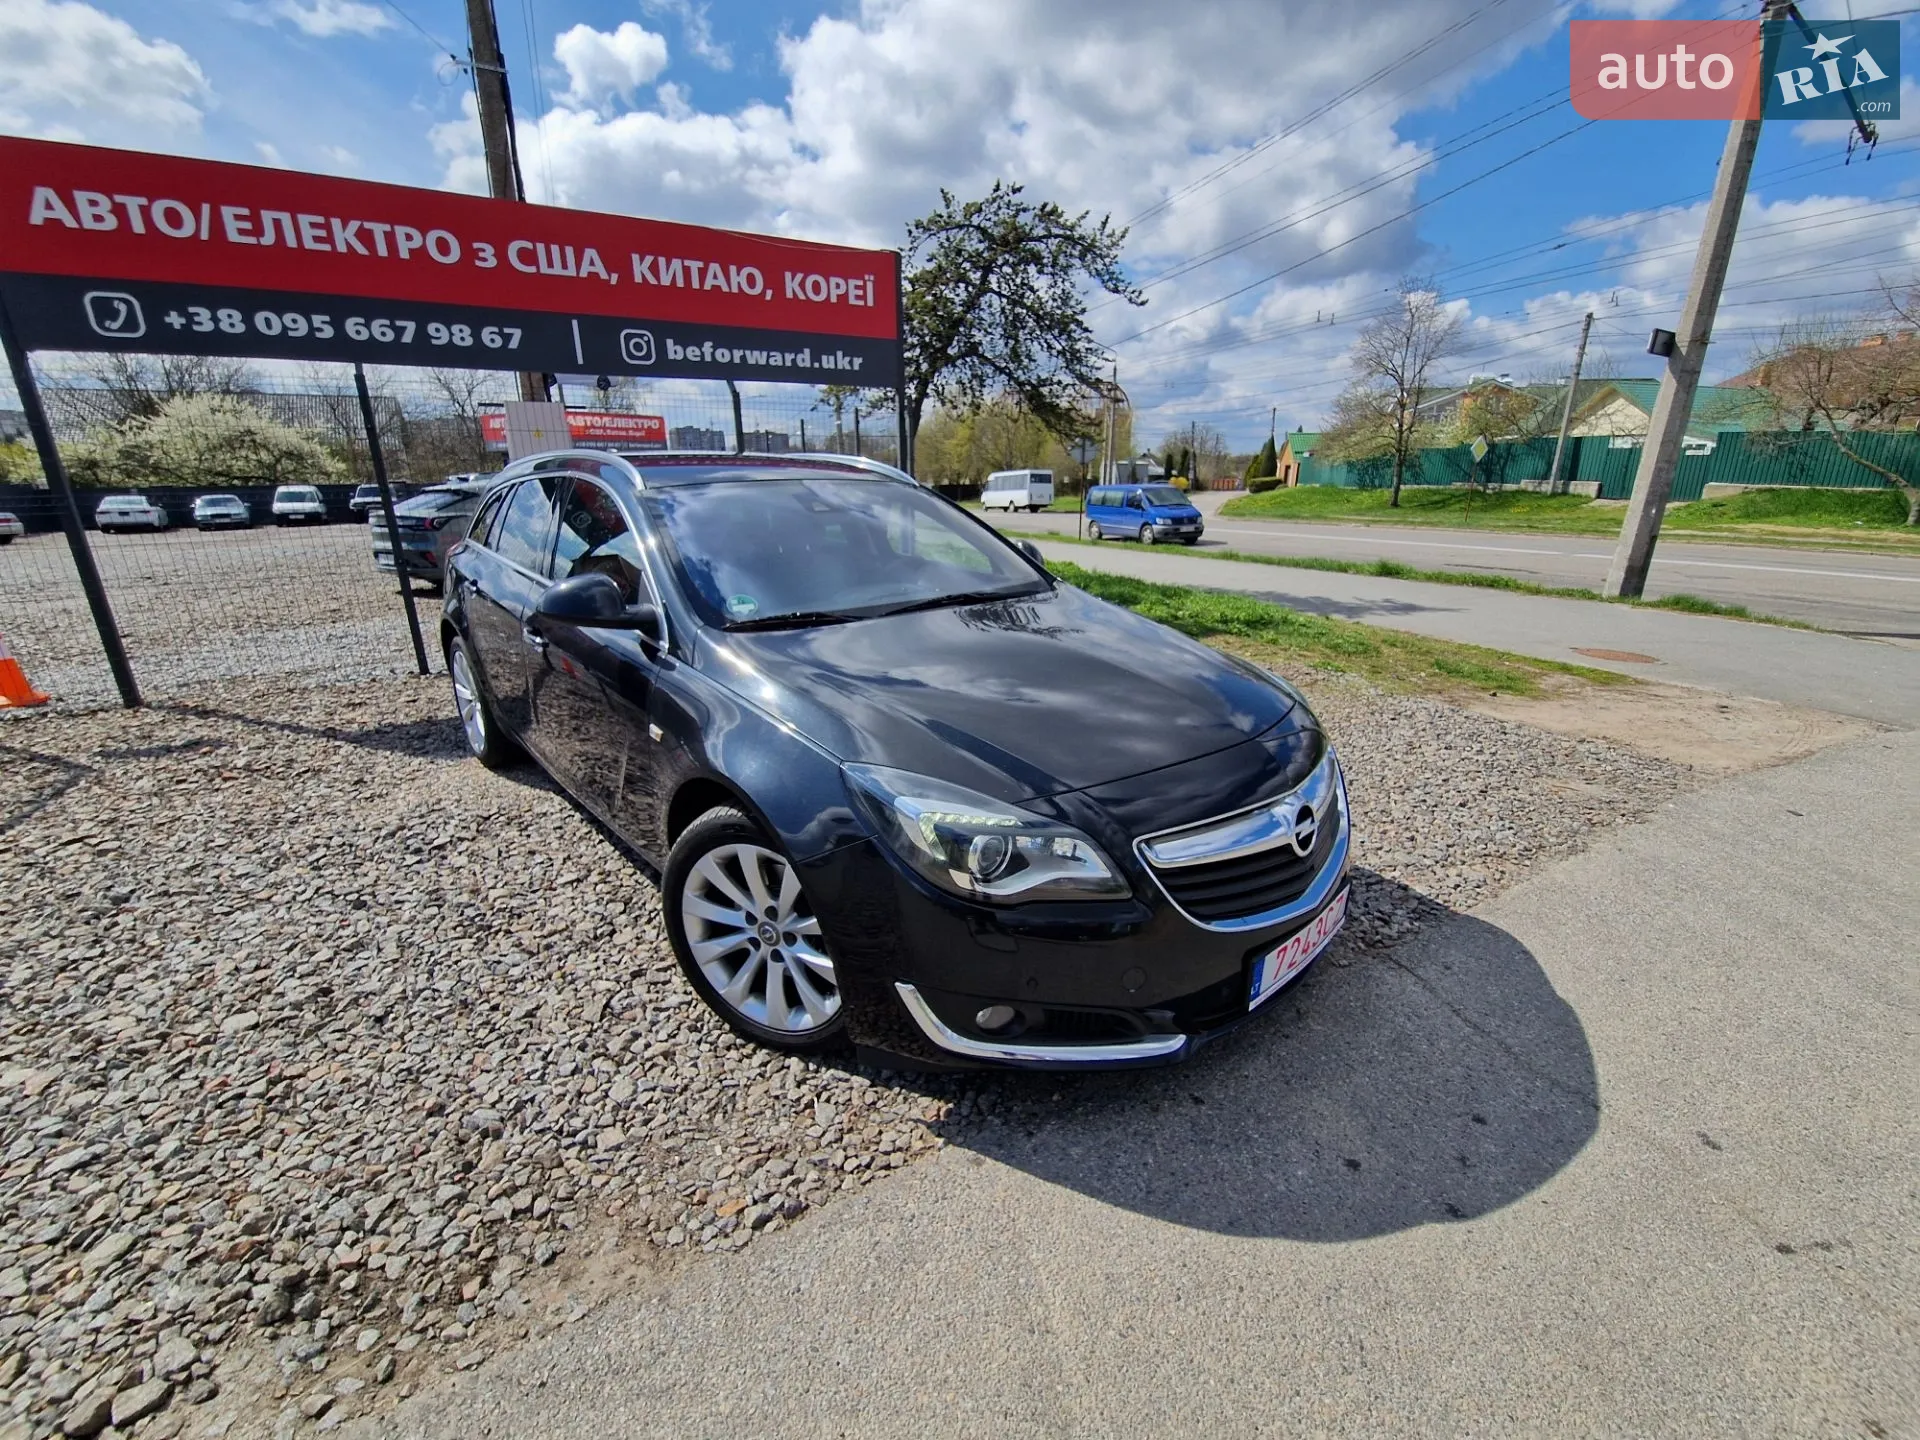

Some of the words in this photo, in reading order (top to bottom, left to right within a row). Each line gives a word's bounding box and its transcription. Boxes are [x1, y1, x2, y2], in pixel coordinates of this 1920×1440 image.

[29, 186, 461, 265] АВТО/ЕЛЕКТРО
[508, 239, 618, 286] США,
[631, 253, 773, 300] КИТАЮ,
[784, 271, 875, 307] КОРЕЇ
[164, 306, 247, 335] +38
[254, 310, 335, 339] 095
[344, 317, 417, 344] 667
[427, 322, 474, 347] 98
[481, 326, 523, 350] 67
[666, 338, 864, 372] beforward.ukr
